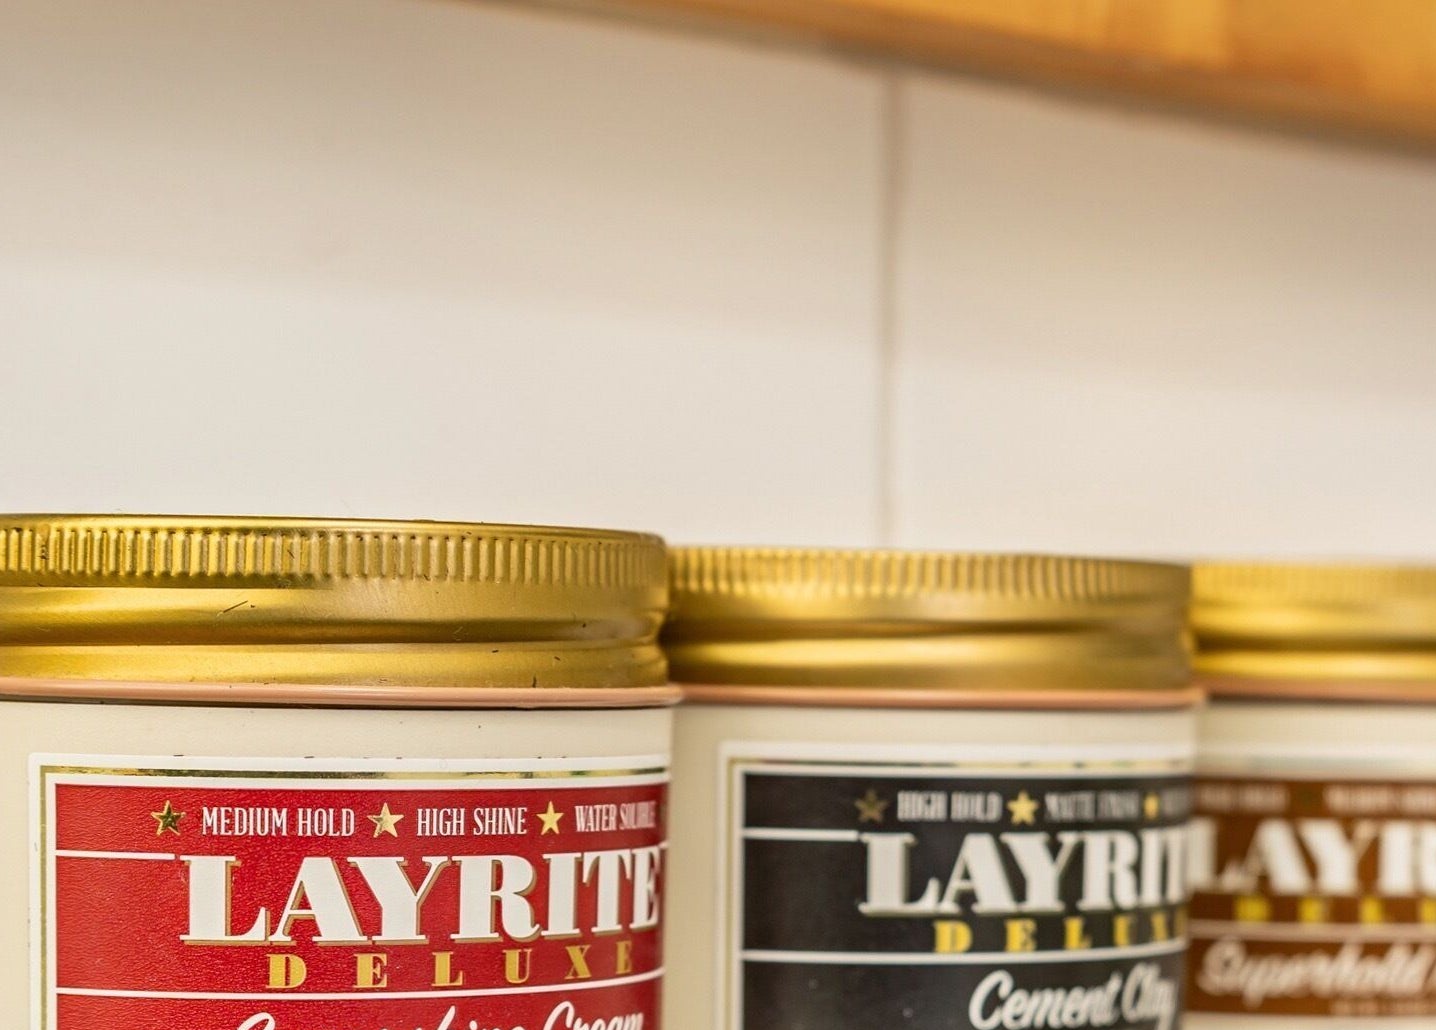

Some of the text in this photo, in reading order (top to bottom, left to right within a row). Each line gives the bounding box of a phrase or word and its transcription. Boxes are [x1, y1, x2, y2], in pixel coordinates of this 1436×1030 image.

[202, 807, 287, 836] MEDIUM
[298, 808, 355, 836] HOLD
[416, 807, 465, 836] HIGH
[473, 806, 528, 836] SHINE
[575, 803, 618, 833] WATER
[180, 846, 662, 945] LAYRITE
[265, 942, 633, 990] DELUXE
[969, 969, 1123, 1030] Cement
